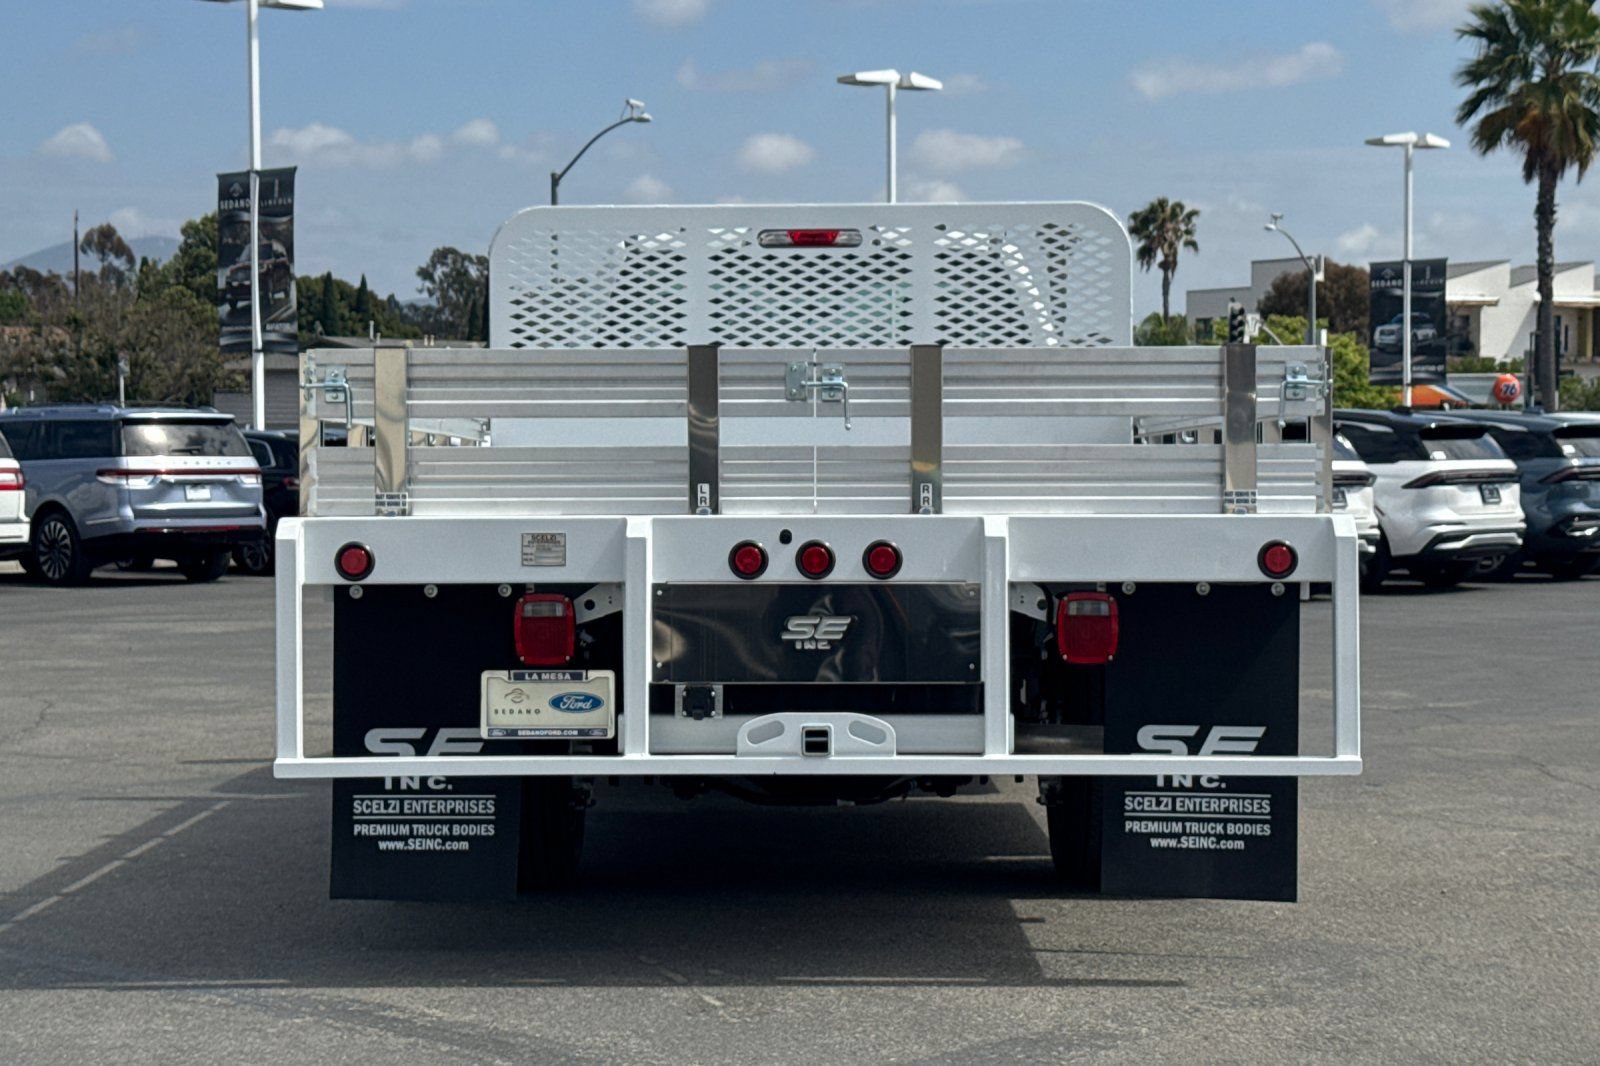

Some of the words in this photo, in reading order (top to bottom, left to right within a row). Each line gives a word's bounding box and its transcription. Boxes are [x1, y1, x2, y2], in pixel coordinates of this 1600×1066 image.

[1371, 279, 1403, 288] SEDANO
[1502, 383, 1518, 396] 76
[781, 615, 851, 640] SE
[525, 672, 539, 680] LA
[541, 672, 571, 680] MESA
[559, 695, 593, 710] Ford
[353, 799, 400, 814] SCELZI
[404, 799, 496, 814] ENTERPRISES
[1124, 796, 1172, 811] SCELZI
[1175, 798, 1271, 814] ENTERPRISES
[353, 824, 410, 836] PREMIUM
[412, 824, 450, 836] TRUCK
[452, 824, 495, 836] BODIES
[1124, 820, 1183, 834] PREMIUM
[1184, 822, 1225, 835] TRUCK
[1226, 823, 1272, 836] BODIES
[378, 838, 469, 850] www.SEINC.com
[1150, 836, 1245, 850] www.SEINC.com
